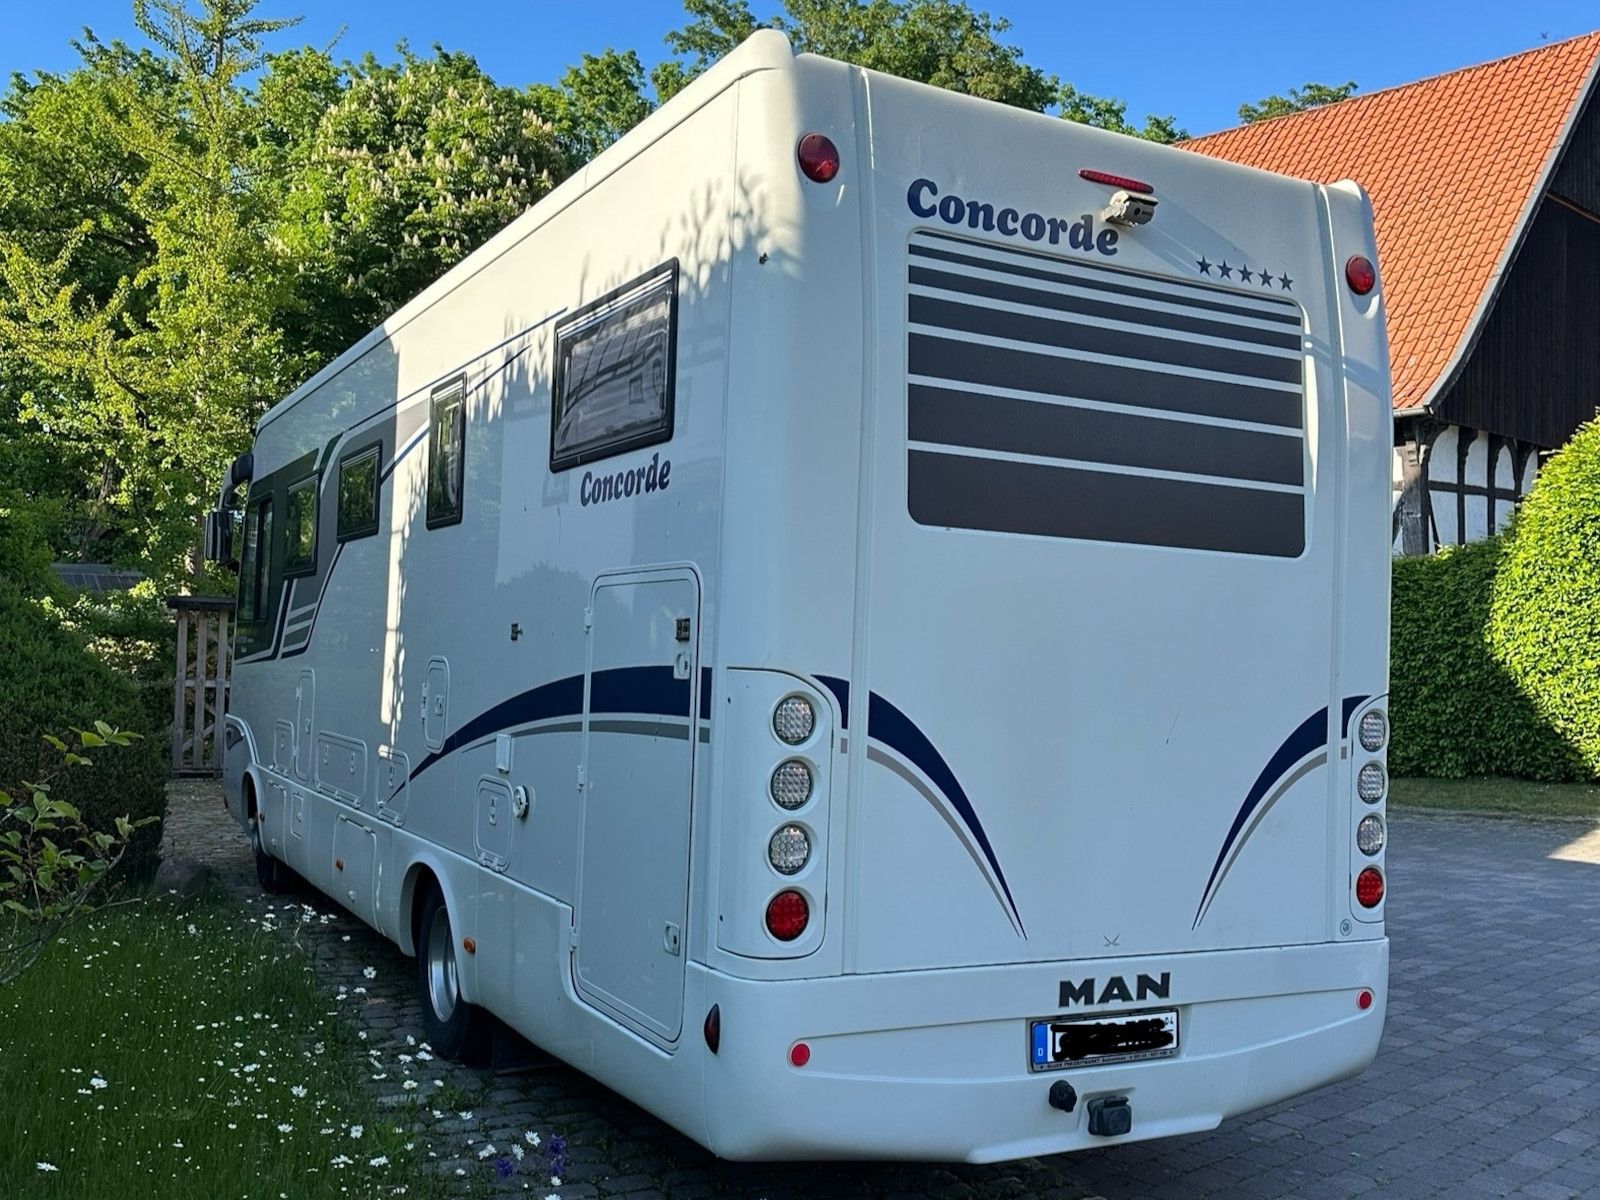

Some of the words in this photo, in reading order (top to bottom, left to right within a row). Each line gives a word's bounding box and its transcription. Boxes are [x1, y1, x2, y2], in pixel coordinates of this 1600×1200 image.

[907, 178, 1119, 256] Concorde
[581, 452, 672, 507] Concorde
[1058, 972, 1171, 1008] MAN
[1037, 1047, 1044, 1057] D
